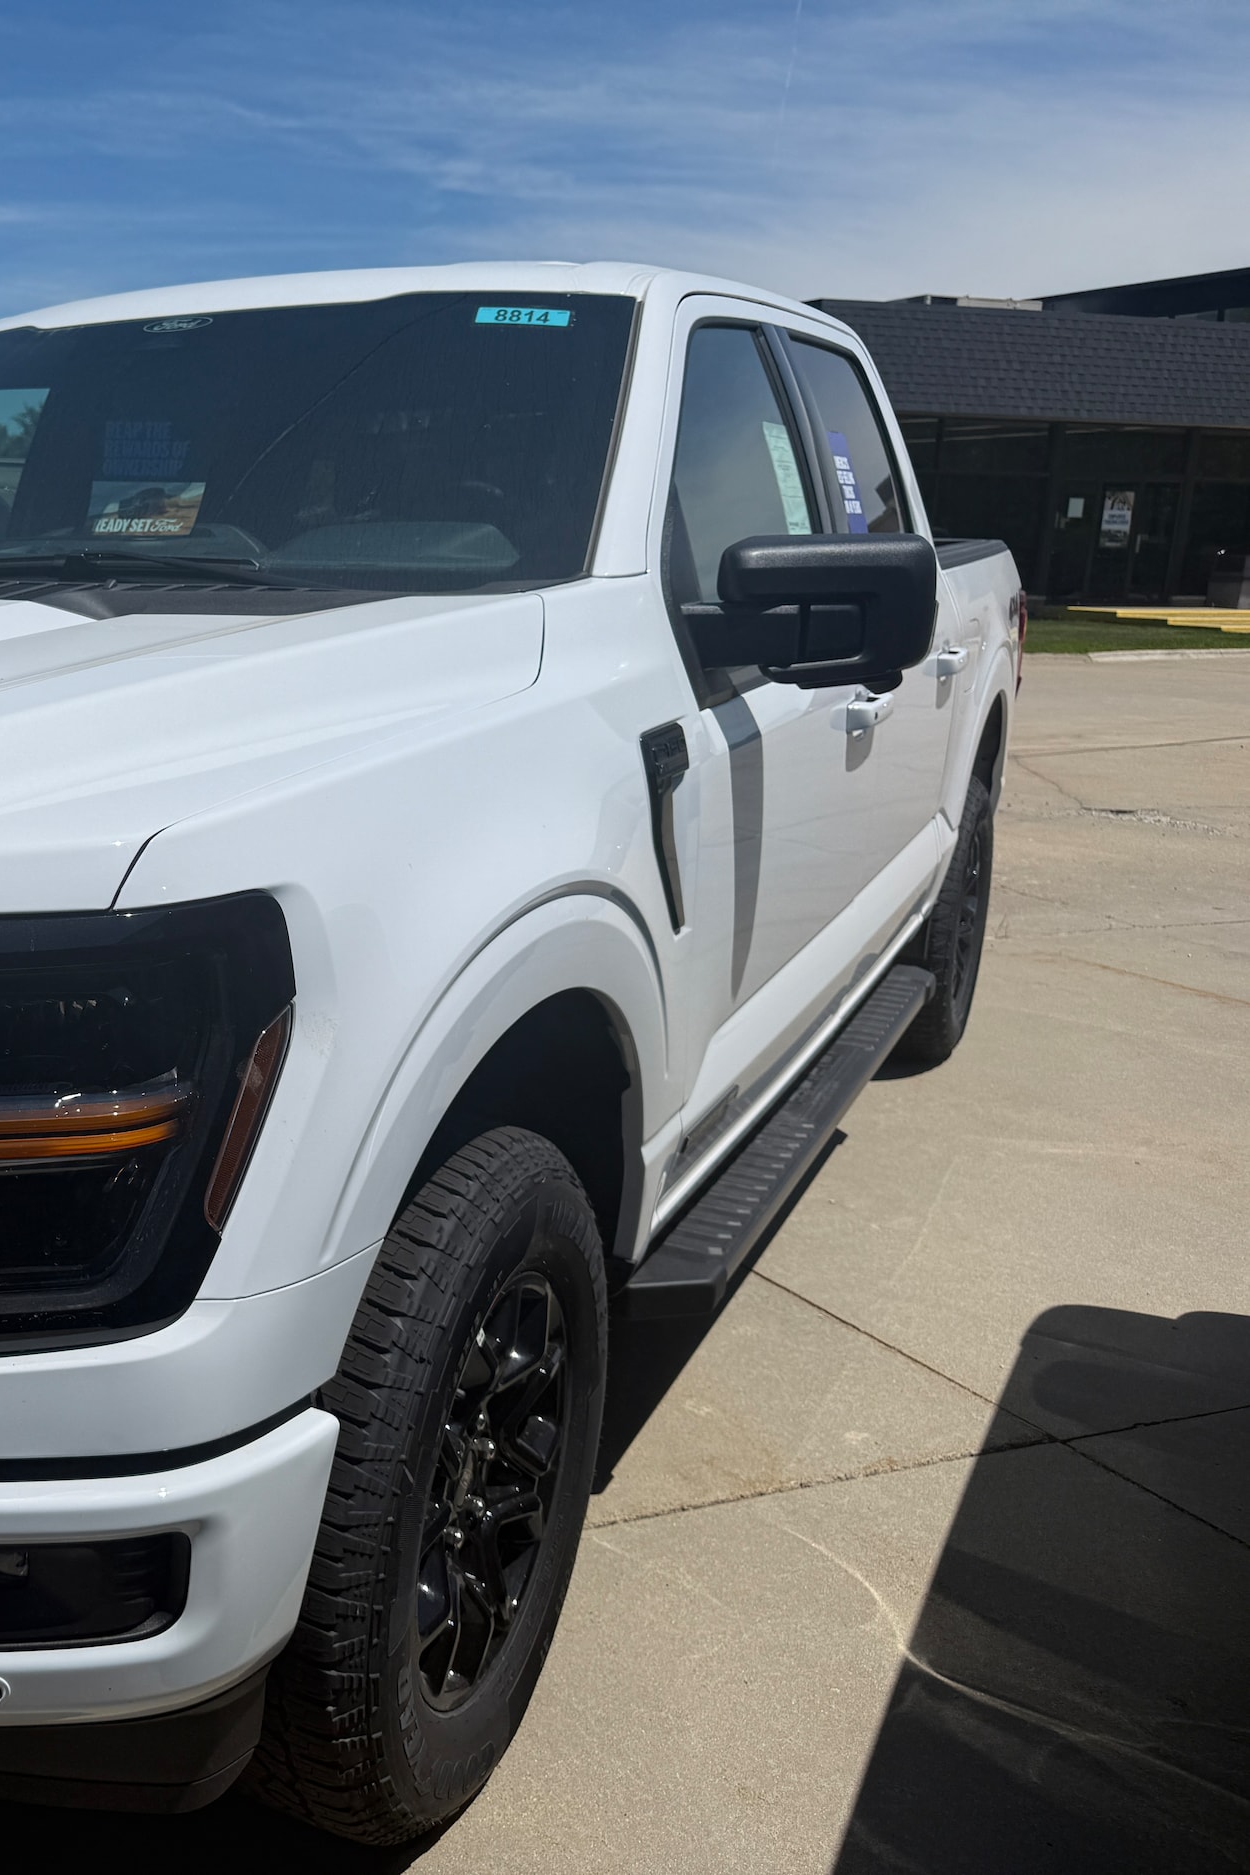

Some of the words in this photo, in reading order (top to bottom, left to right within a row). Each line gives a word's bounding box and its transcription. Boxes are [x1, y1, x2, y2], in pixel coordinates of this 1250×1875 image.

[494, 309, 550, 323] 8814
[153, 319, 203, 331] Ford
[105, 421, 143, 439] REAP
[145, 421, 172, 439] THE
[104, 440, 170, 458] REWARDS
[172, 440, 191, 458] OF
[102, 459, 184, 477] OWNERSHIP
[129, 519, 153, 533] SET
[150, 519, 184, 532] Ford
